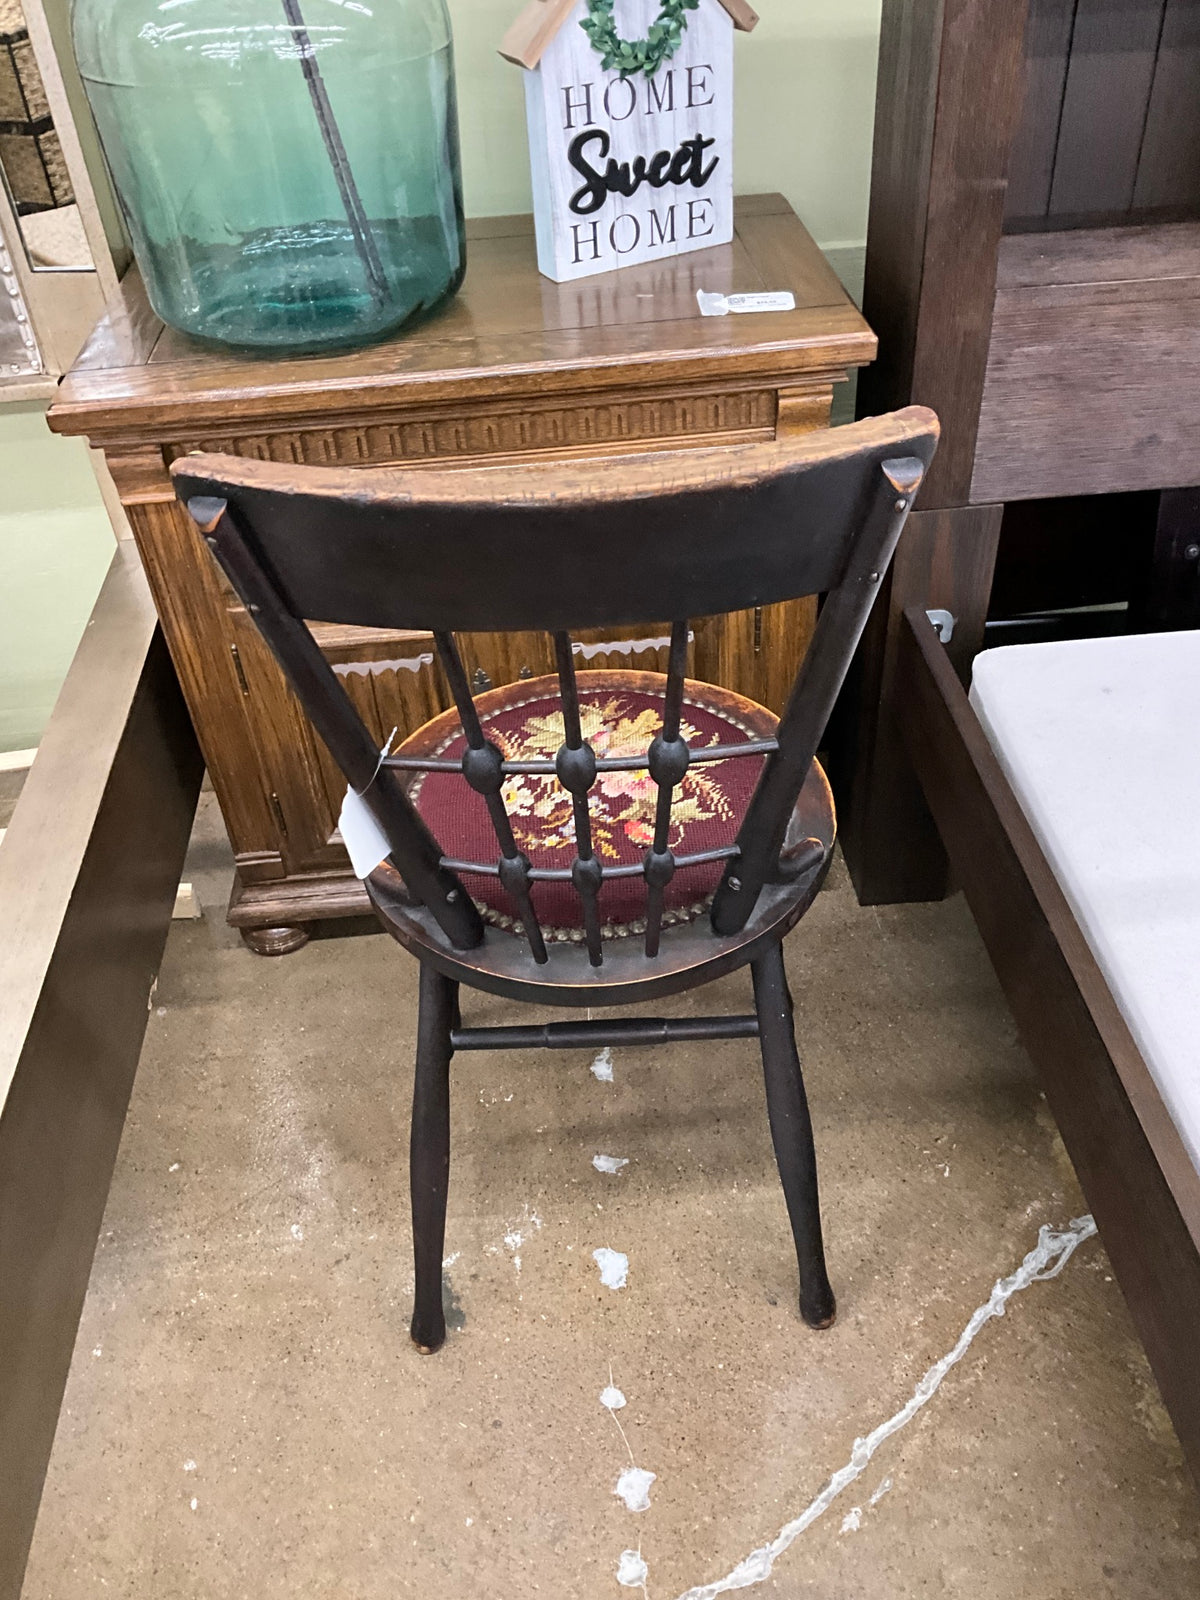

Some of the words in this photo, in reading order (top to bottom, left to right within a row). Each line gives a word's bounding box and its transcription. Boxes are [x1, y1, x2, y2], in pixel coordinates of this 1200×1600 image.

[561, 64, 715, 129] HOME
[567, 129, 720, 215] Sweet
[570, 198, 715, 263] HOME
